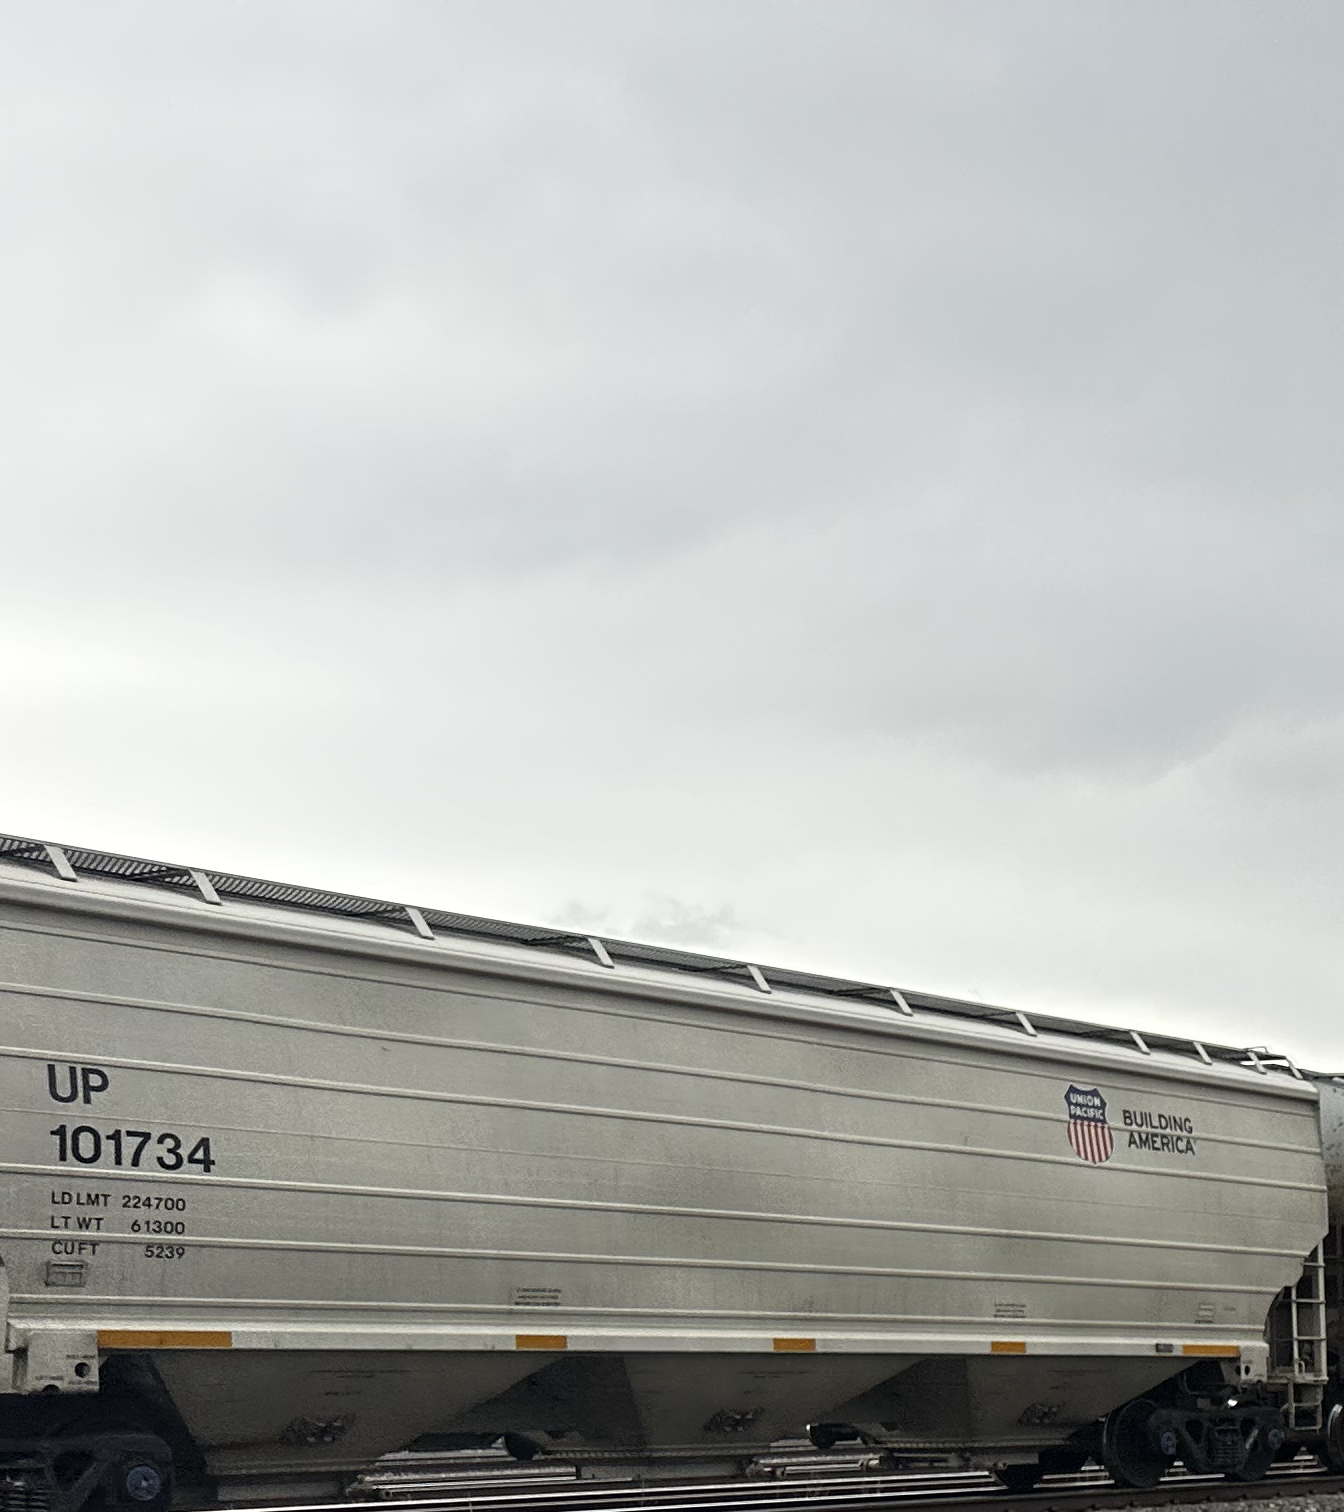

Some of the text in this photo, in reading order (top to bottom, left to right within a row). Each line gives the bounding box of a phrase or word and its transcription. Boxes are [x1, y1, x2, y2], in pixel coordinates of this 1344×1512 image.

[47, 1064, 109, 1104] UP
[1069, 1092, 1101, 1107] UNION
[1070, 1105, 1104, 1120] PACIFIC
[1122, 1109, 1193, 1134] BUILDING
[50, 1124, 215, 1173] 101734
[1128, 1131, 1196, 1156] AMERICA
[51, 1190, 186, 1211] LD LMT 224700
[50, 1215, 186, 1235] LT WT 61300
[51, 1240, 186, 1260] CU FT 5239
